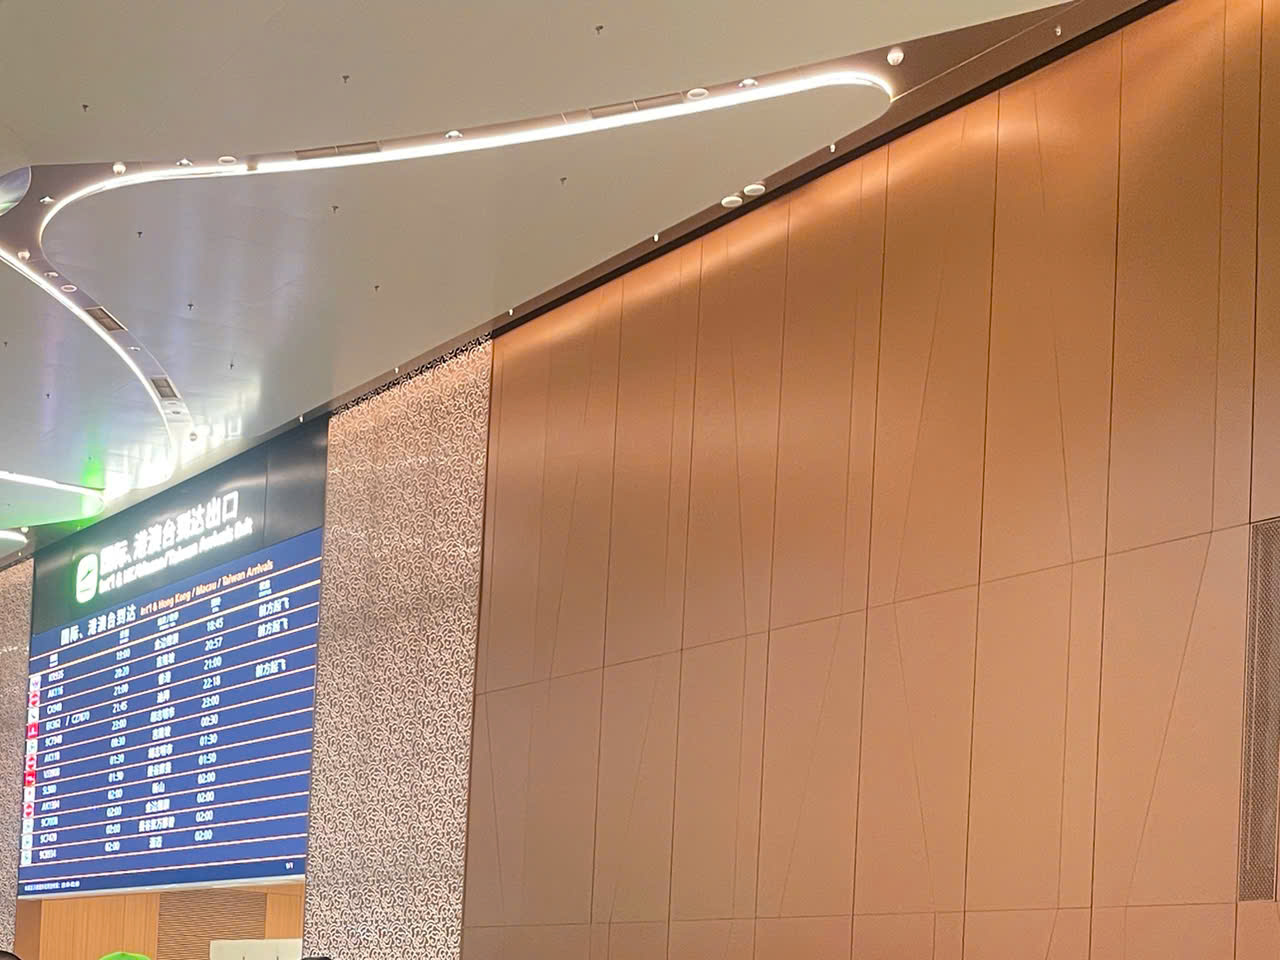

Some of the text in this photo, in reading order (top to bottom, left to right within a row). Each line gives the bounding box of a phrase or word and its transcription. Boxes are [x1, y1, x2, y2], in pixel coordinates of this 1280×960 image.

[222, 570, 246, 586] Taiwan
[247, 559, 274, 577] Arrivals
[207, 617, 224, 632] 18:45
[205, 637, 223, 651] 20:57
[204, 656, 222, 670] 21:00
[203, 676, 220, 689] 22:18
[202, 695, 219, 708] 23:00
[201, 714, 218, 727] 00:30
[200, 733, 218, 746] 01:30
[198, 752, 216, 765] 01:50
[198, 772, 216, 784] 02:00
[197, 791, 214, 803] 02:00
[196, 810, 213, 822] 02:00
[195, 830, 212, 841] 02:00
